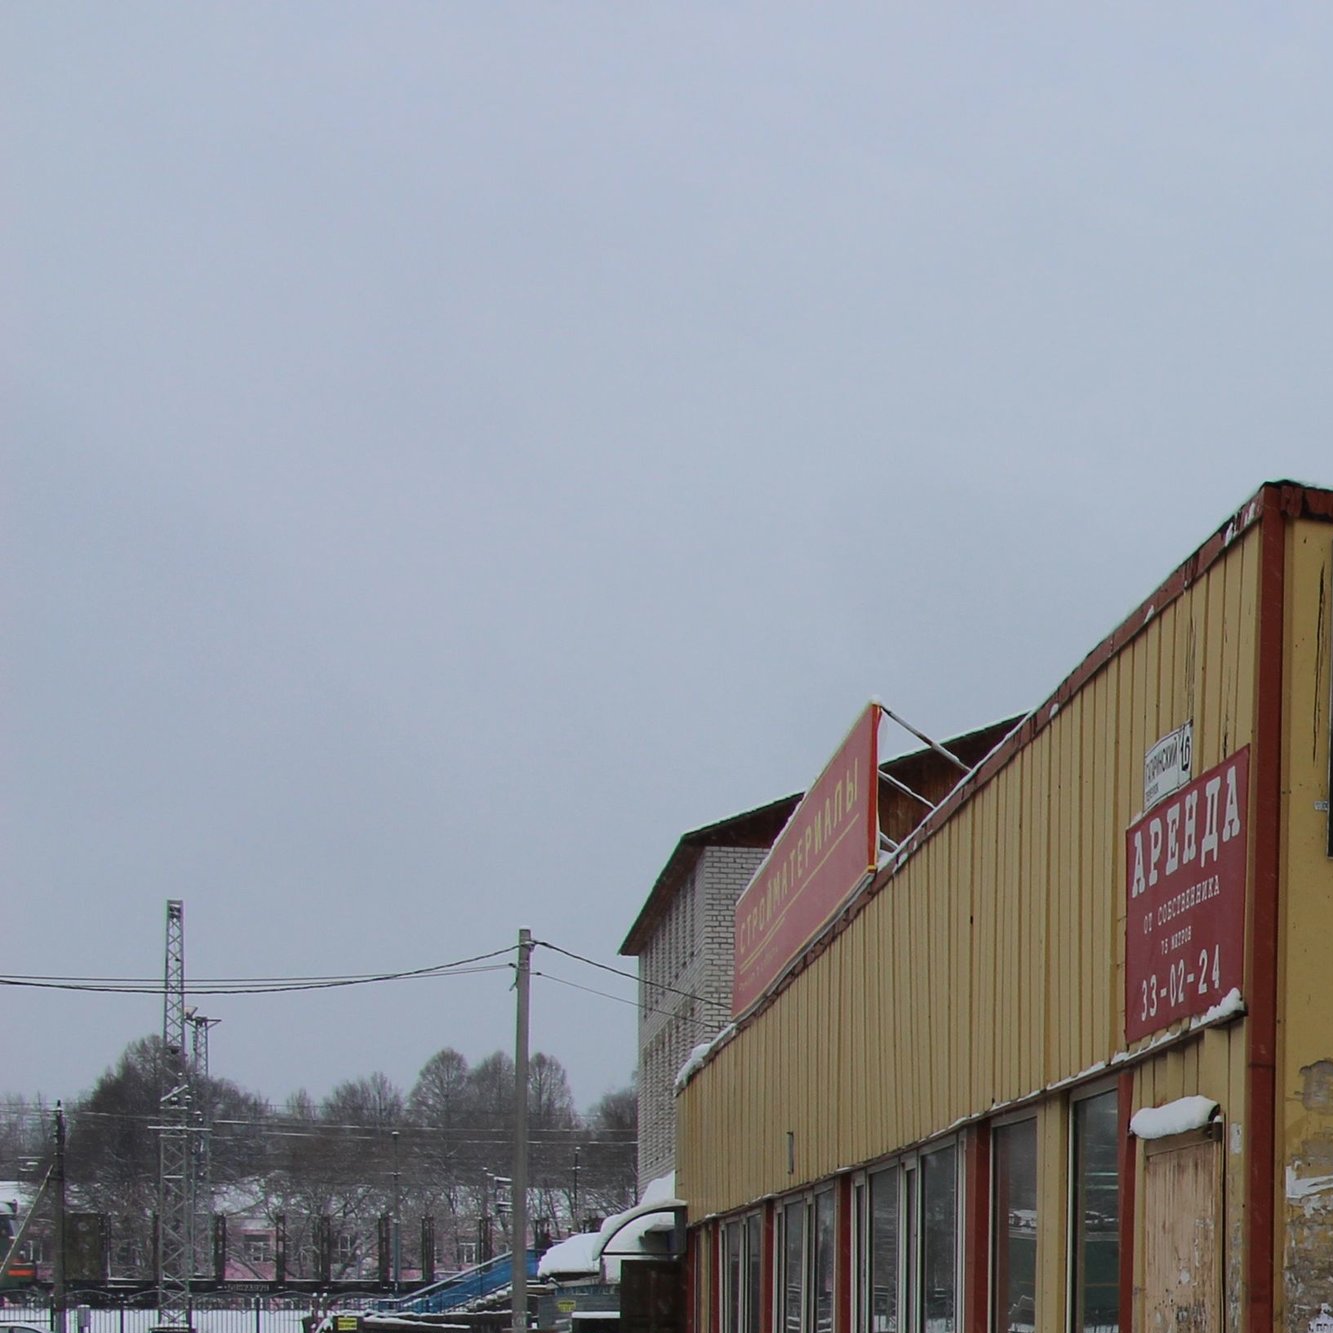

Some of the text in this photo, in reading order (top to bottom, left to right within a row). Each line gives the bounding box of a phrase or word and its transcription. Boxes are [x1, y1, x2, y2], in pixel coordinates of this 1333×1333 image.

[739, 758, 859, 954] СТРОЙМАТЕРИАЛЫ
[1131, 765, 1241, 899] АРЕНДА
[1143, 874, 1221, 935] ОТ СОБСТВЕННИКА
[1141, 943, 1221, 1022] 33-02-24
